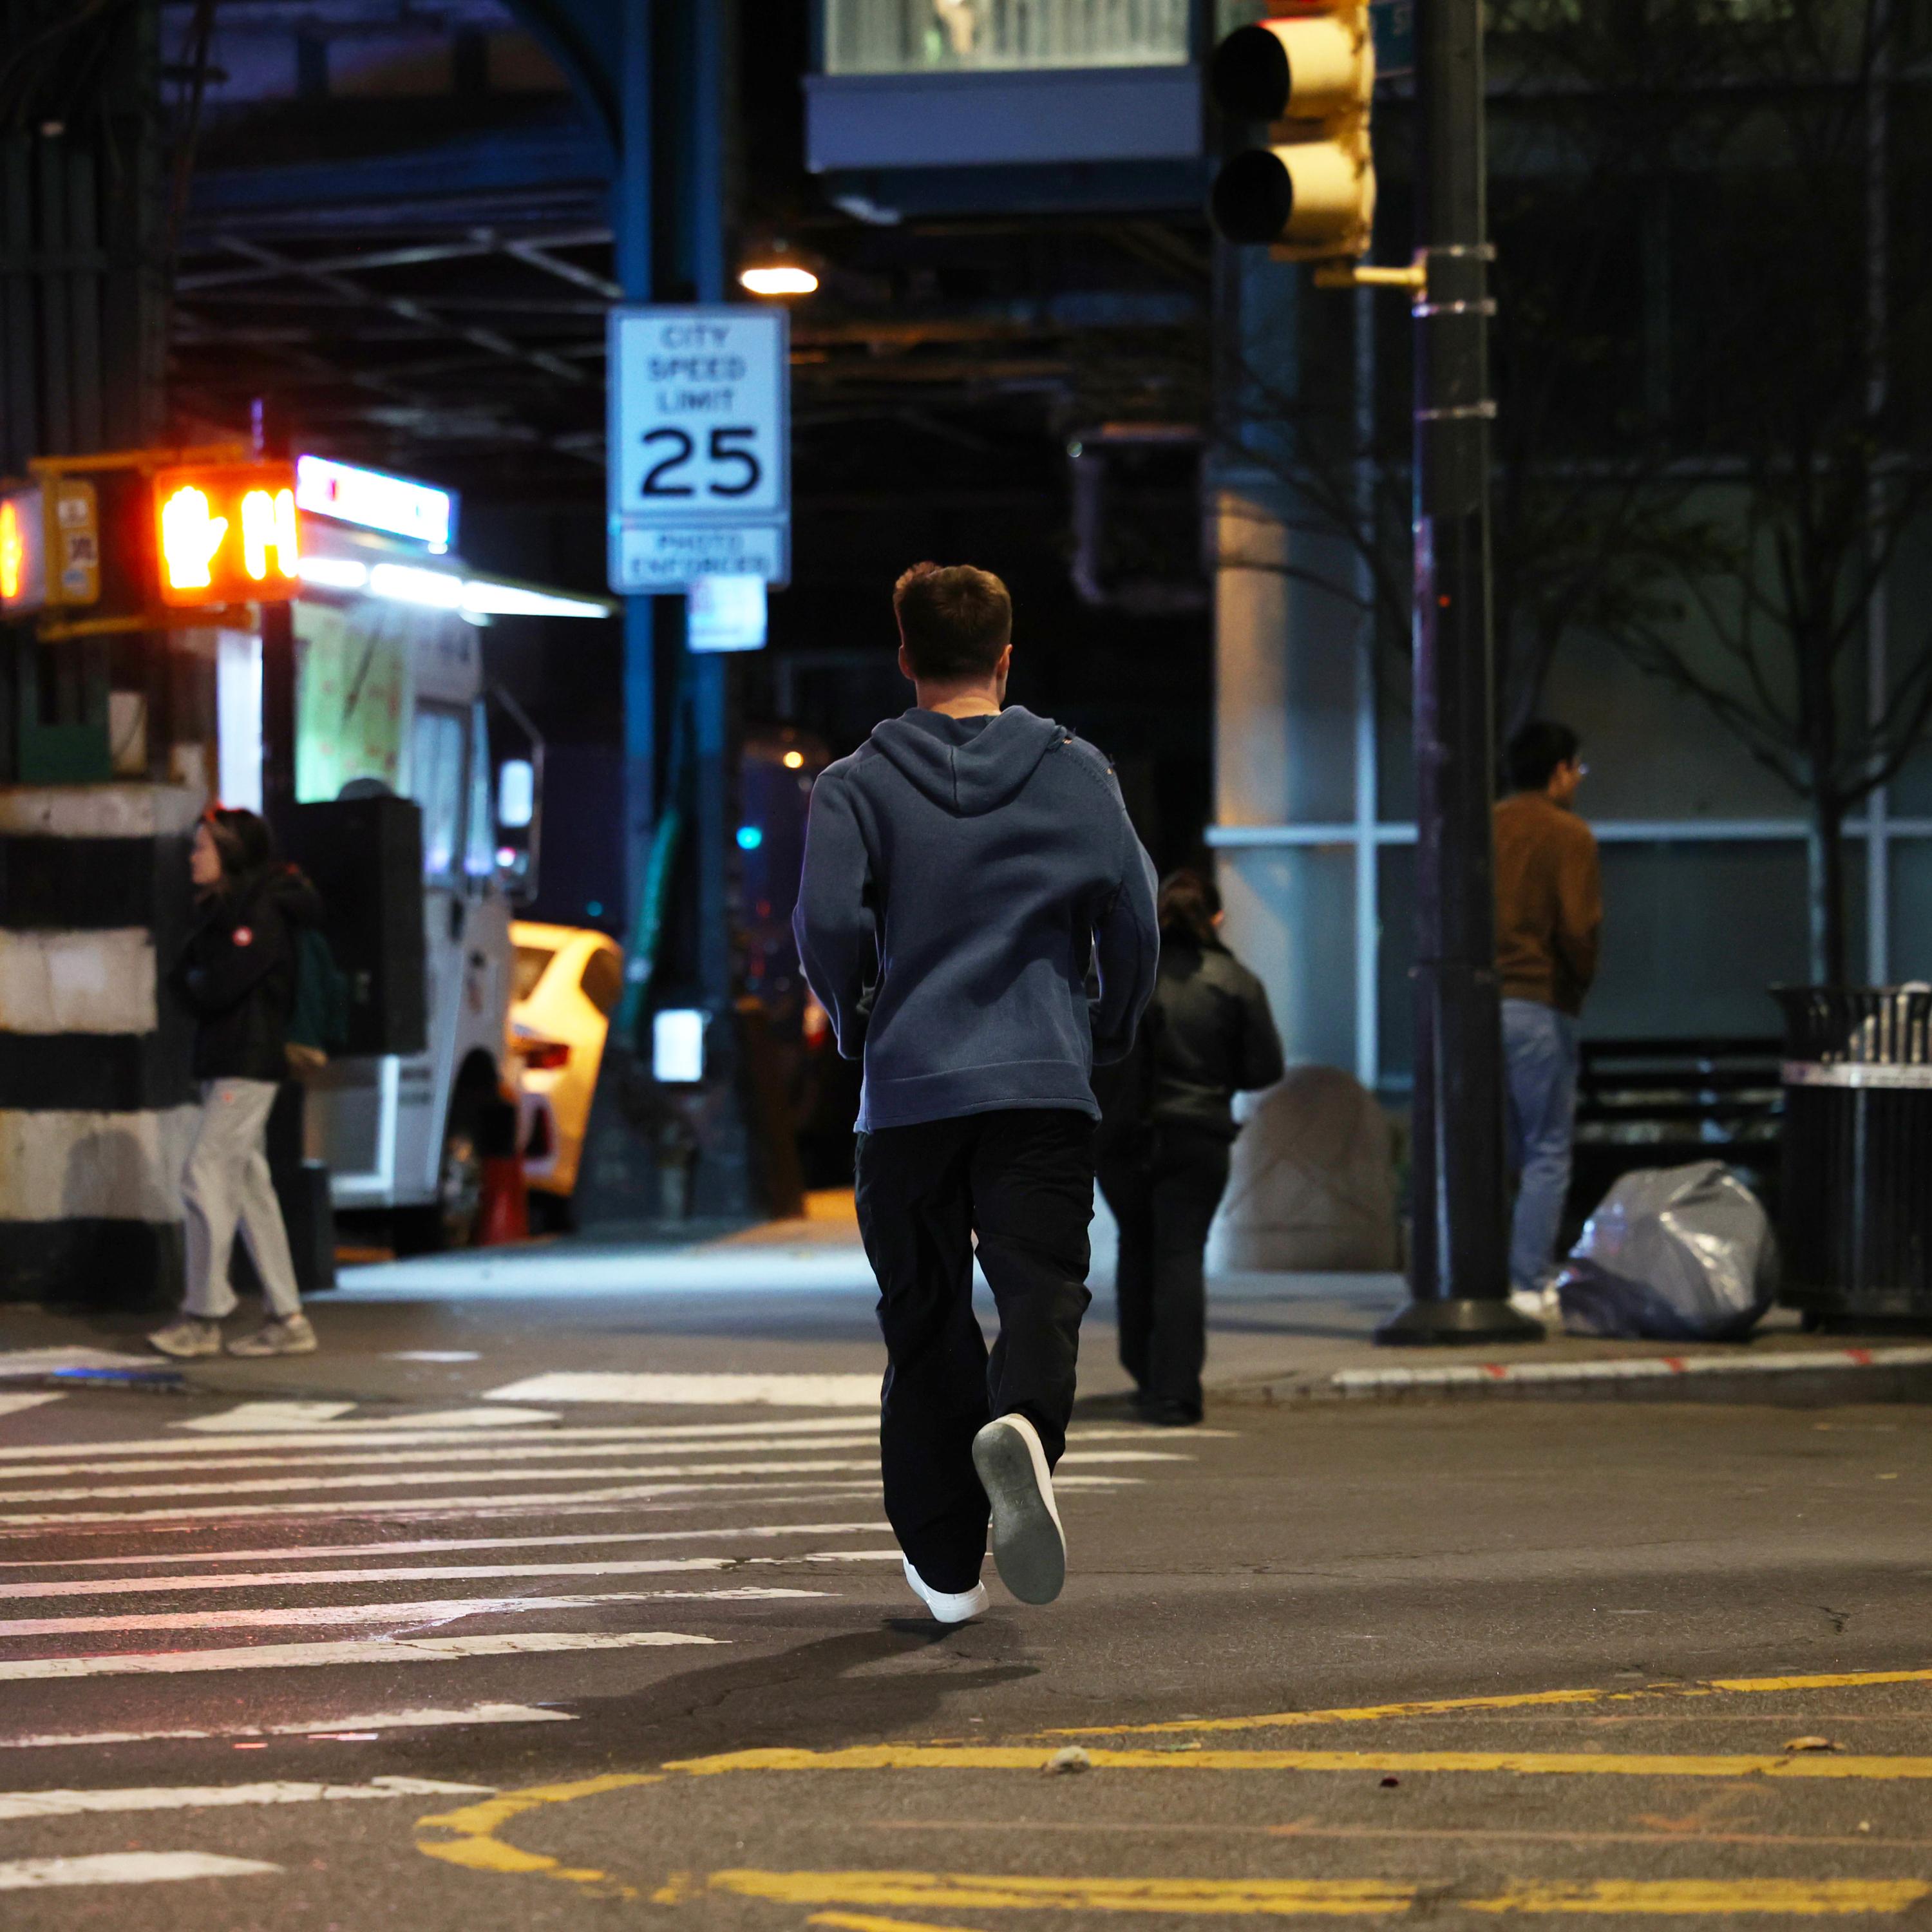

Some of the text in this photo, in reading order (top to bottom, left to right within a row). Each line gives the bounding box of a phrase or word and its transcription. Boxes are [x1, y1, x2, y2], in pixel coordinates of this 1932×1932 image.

[659, 325, 730, 350] CITY
[647, 355, 747, 382] SPEED
[656, 388, 734, 413] LIMIT
[641, 427, 761, 497] 25
